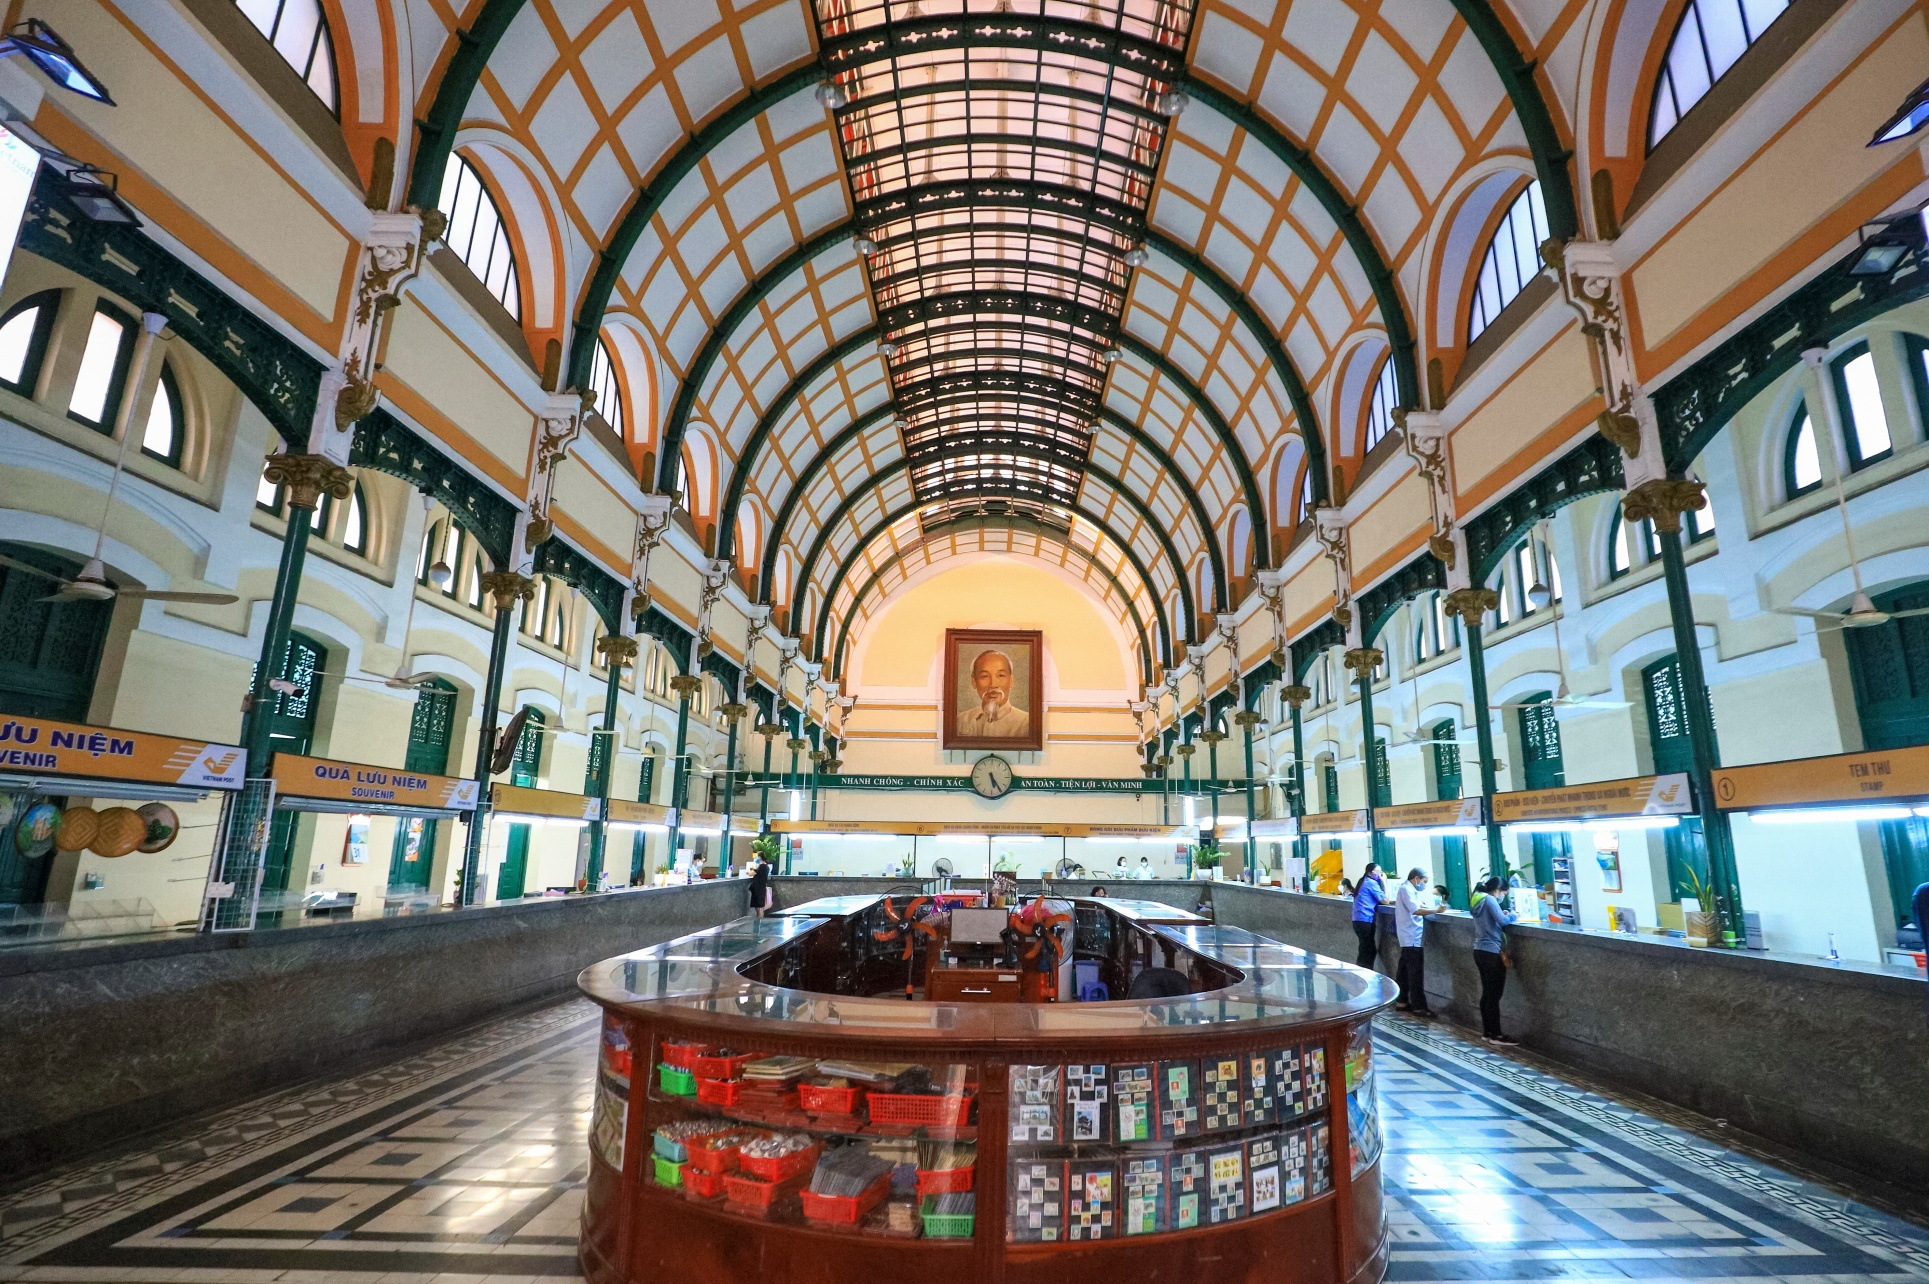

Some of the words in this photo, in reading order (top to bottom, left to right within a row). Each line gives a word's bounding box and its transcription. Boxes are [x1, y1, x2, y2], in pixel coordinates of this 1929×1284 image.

[50, 731, 135, 757] NIỆM
[1849, 763, 1869, 778] TEM
[315, 765, 350, 781] QUẢ
[357, 770, 387, 785] LƯU
[392, 775, 428, 791] NIỆM
[841, 777, 871, 785] NHANH
[873, 776, 904, 786] CHÓNG
[914, 777, 943, 786] CHÍNH
[946, 777, 965, 787] XÁC
[1020, 780, 1032, 788] AN
[1033, 779, 1055, 788] TOÀN
[1061, 779, 1080, 789] TIỆN
[1102, 779, 1119, 789] VĂN
[1120, 781, 1143, 789] MINH
[351, 787, 395, 800] SOUVENIR
[1860, 782, 1883, 792] STAMP
